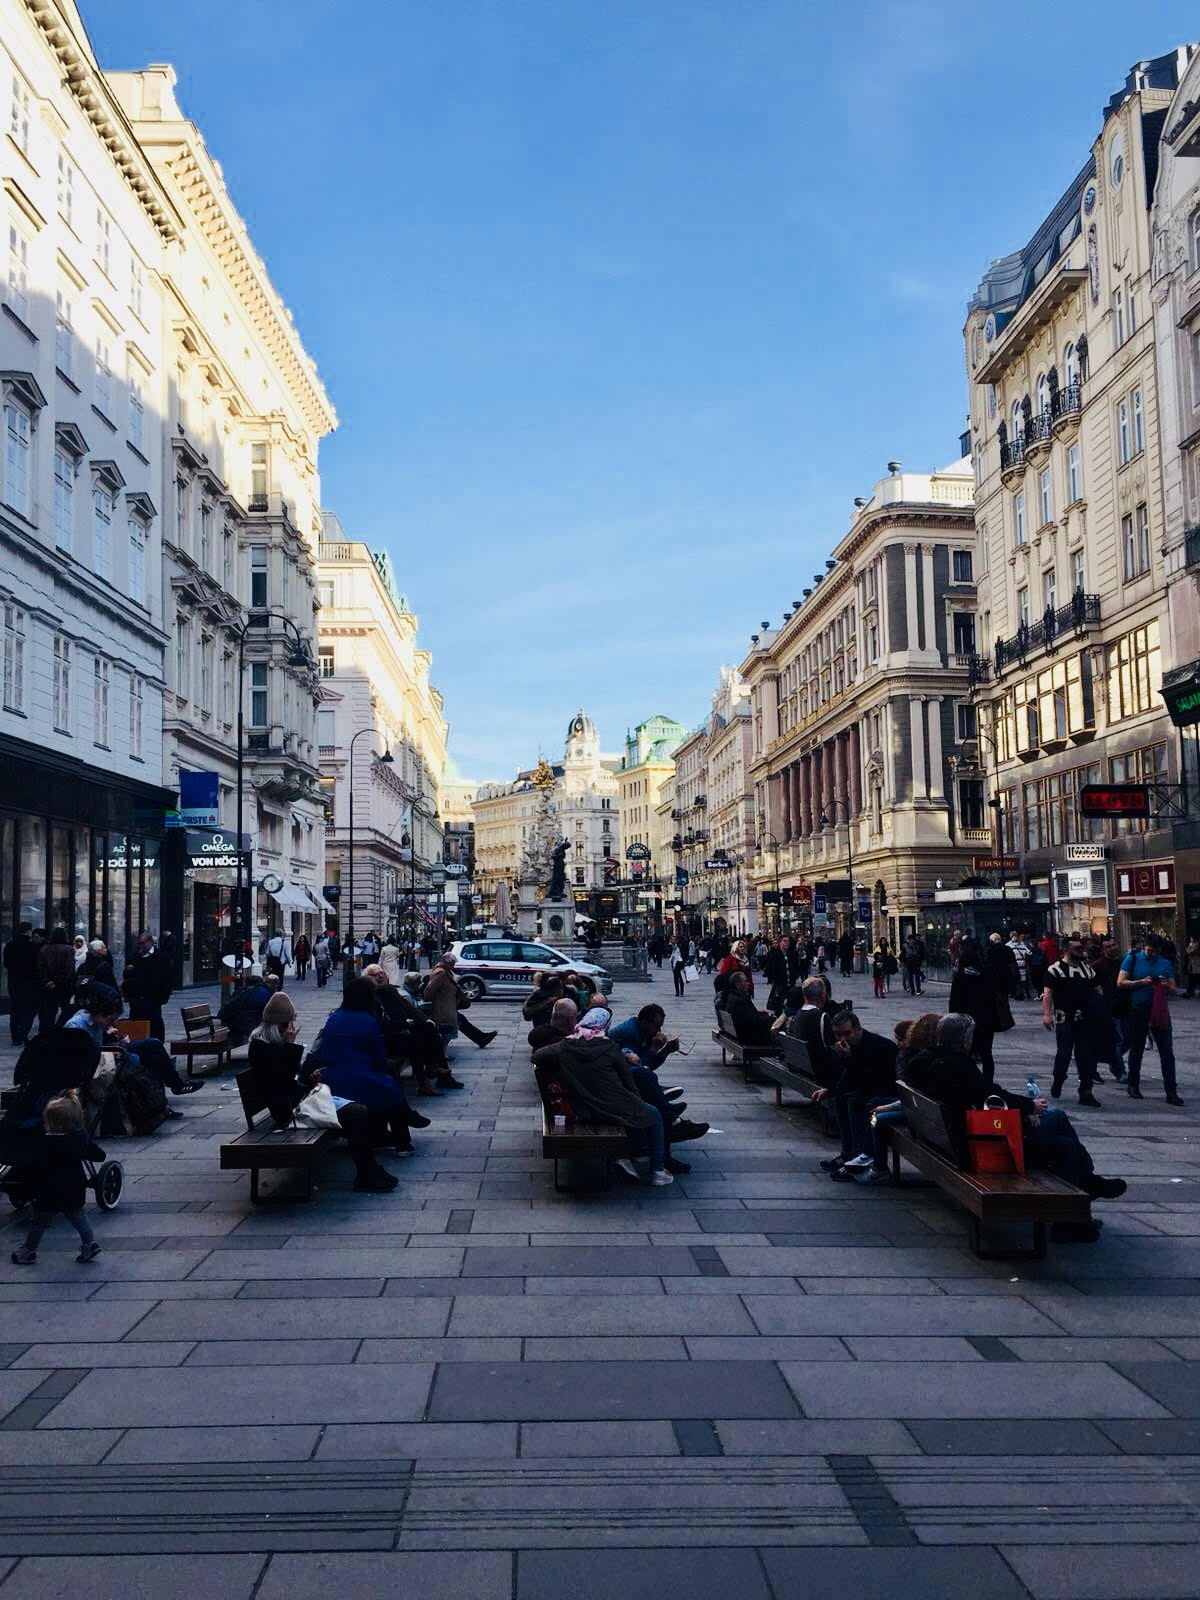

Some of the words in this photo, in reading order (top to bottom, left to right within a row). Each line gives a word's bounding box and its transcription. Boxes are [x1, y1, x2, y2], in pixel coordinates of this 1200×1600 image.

[183, 816, 208, 824] ERSTE
[202, 843, 235, 851] OMEGA
[192, 857, 213, 867] VON
[499, 973, 533, 981] POLIZE
